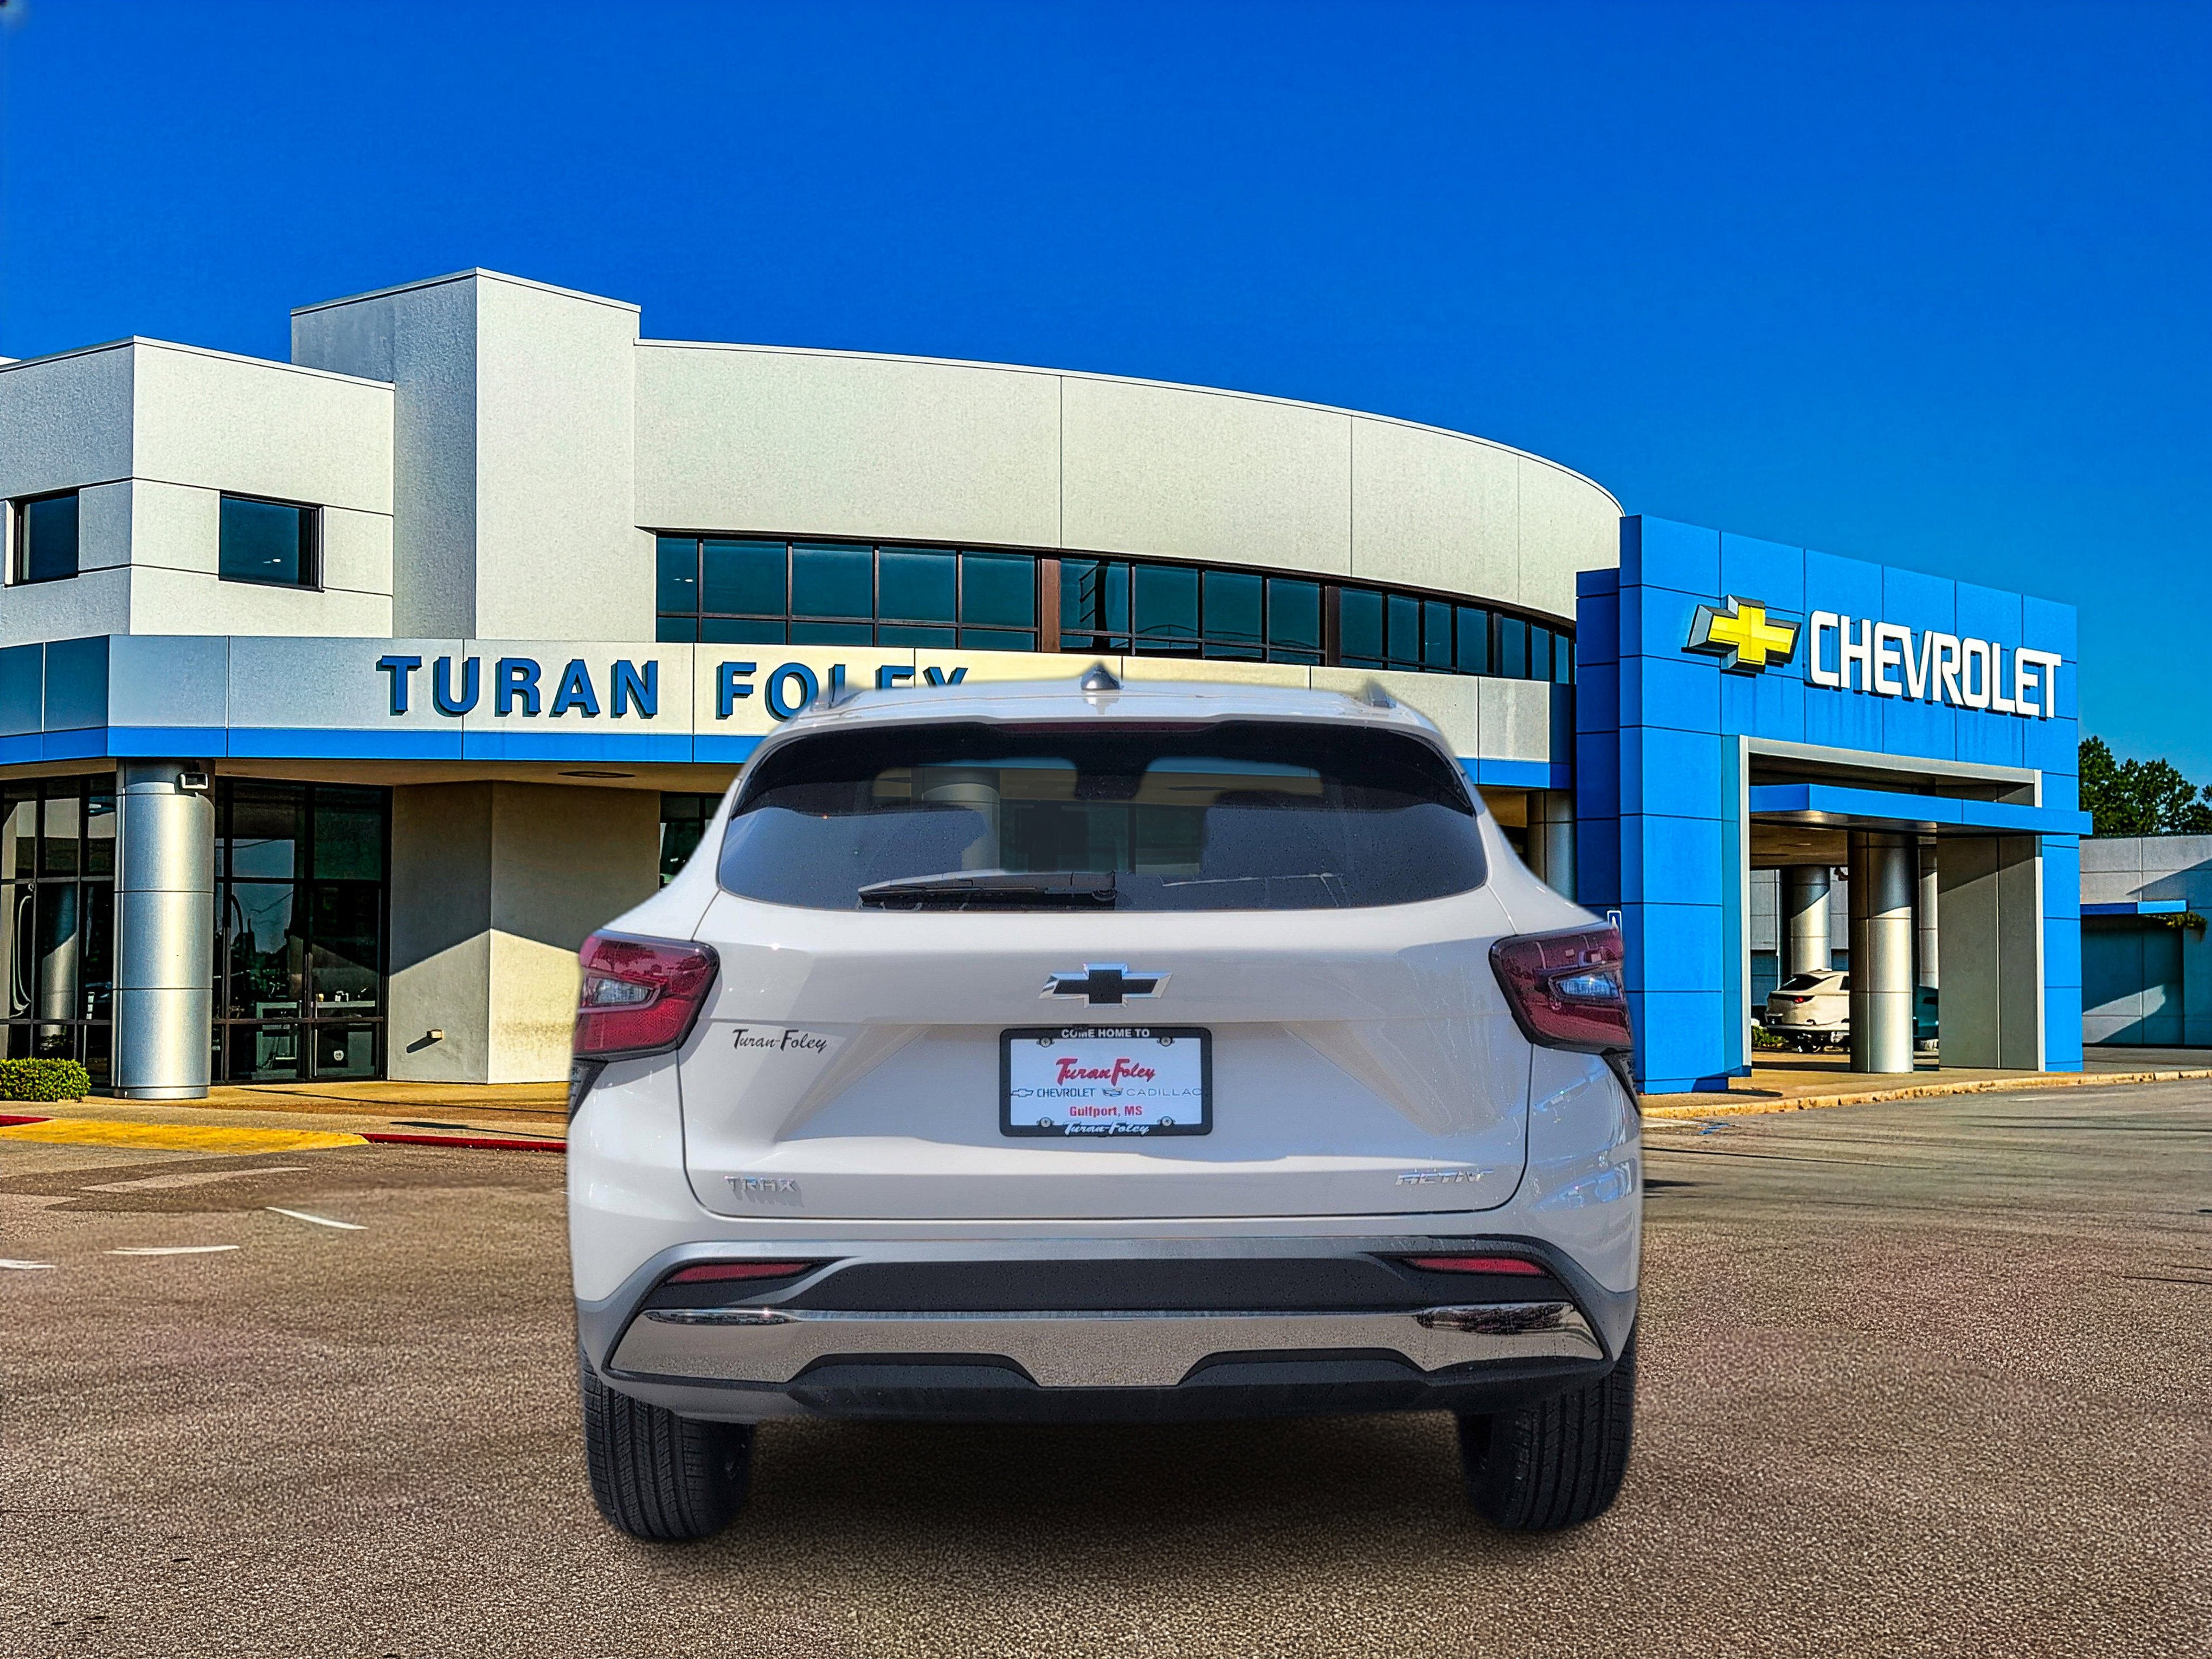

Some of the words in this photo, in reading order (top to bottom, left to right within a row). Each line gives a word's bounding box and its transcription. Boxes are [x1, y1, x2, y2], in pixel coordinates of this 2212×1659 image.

[1810, 610, 2062, 718] CHEVROLET
[376, 655, 658, 718] TURAN
[1098, 1028, 1132, 1038] HOME
[1135, 1028, 1150, 1038] TO
[1037, 1088, 1096, 1097] CHEVROLET
[1126, 1088, 1202, 1096] CADILLAC
[1070, 1106, 1121, 1117] Gulfport,
[1124, 1105, 1142, 1116] MS
[724, 1175, 797, 1192] TRAX
